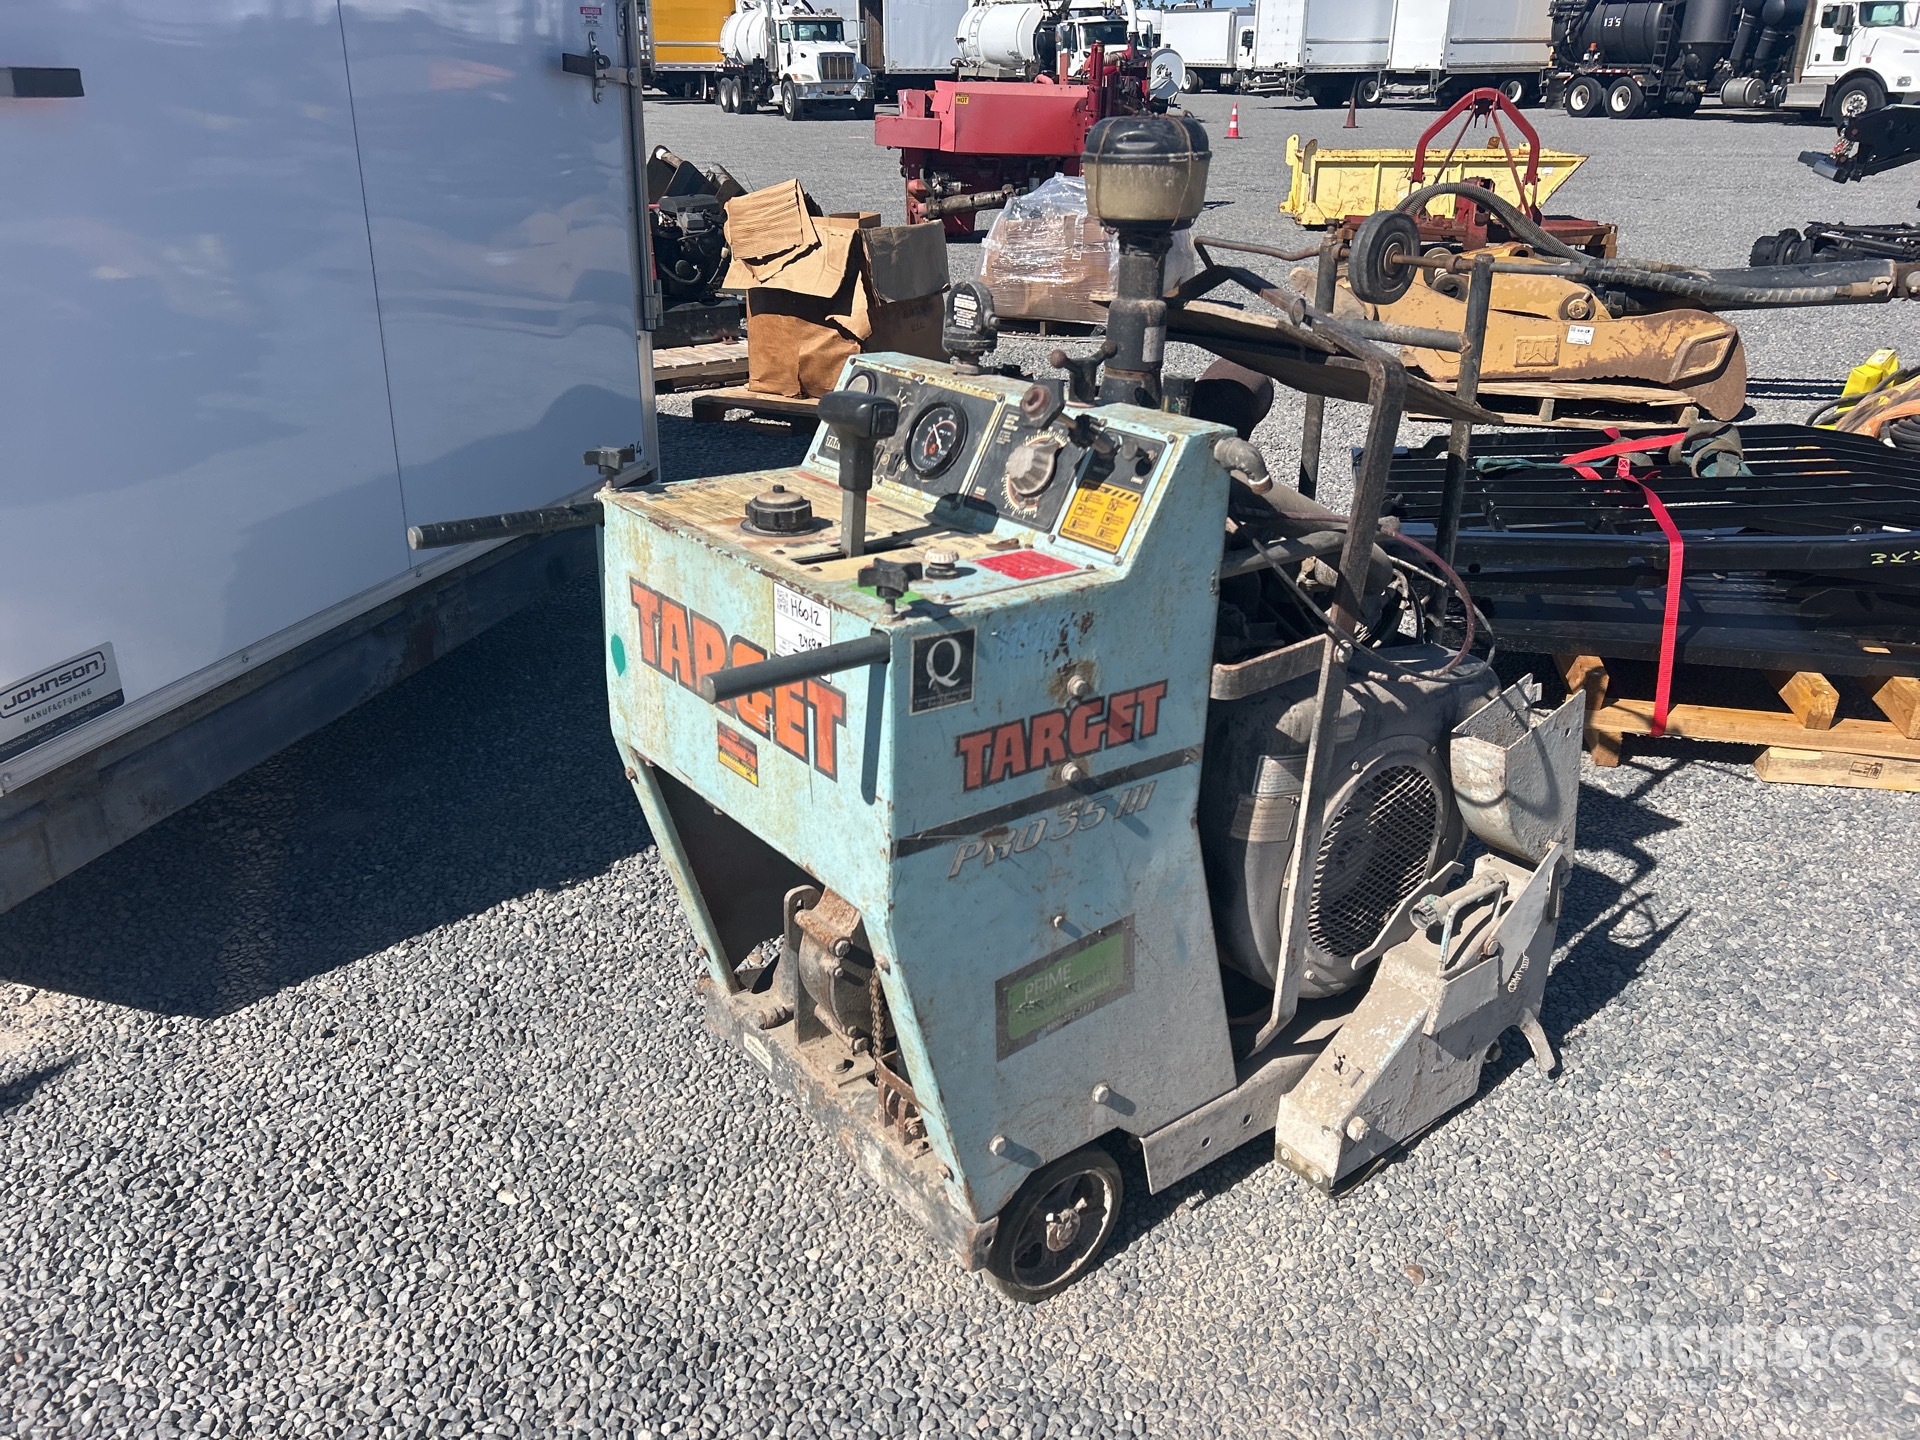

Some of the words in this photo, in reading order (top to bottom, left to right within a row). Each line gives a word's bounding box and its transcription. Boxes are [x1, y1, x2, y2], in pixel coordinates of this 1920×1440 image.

[1520, 340, 1557, 361] CAT
[4, 660, 99, 710] JOHNSON
[629, 576, 847, 784] TARGET
[926, 638, 961, 689] Q
[24, 688, 92, 724] MANUFACTURING
[956, 679, 1168, 792] TARGET
[948, 818, 1047, 878] PRO
[1050, 794, 1113, 841] 35
[1025, 963, 1071, 1001] PRIME
